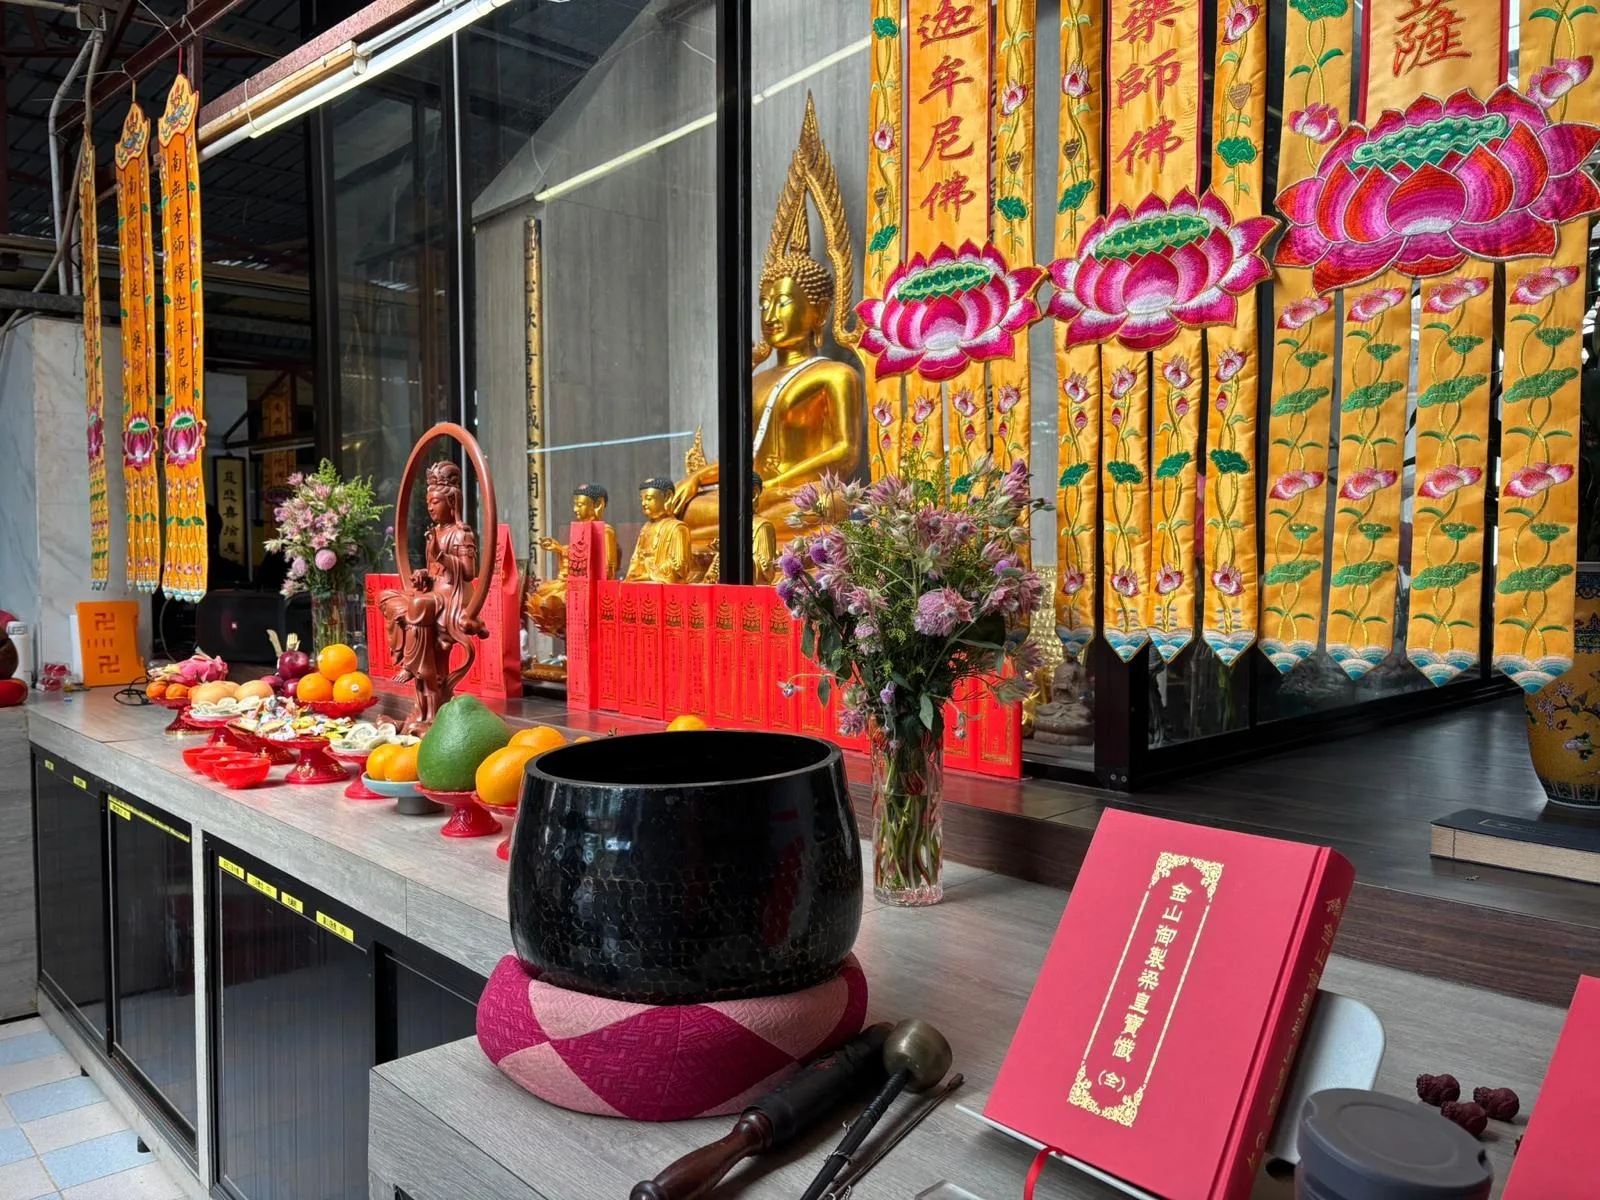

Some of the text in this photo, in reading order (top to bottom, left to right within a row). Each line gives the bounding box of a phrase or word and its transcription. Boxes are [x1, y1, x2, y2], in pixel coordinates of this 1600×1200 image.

[1112, 882, 1192, 1063] 金山御製梁皇寶懺
